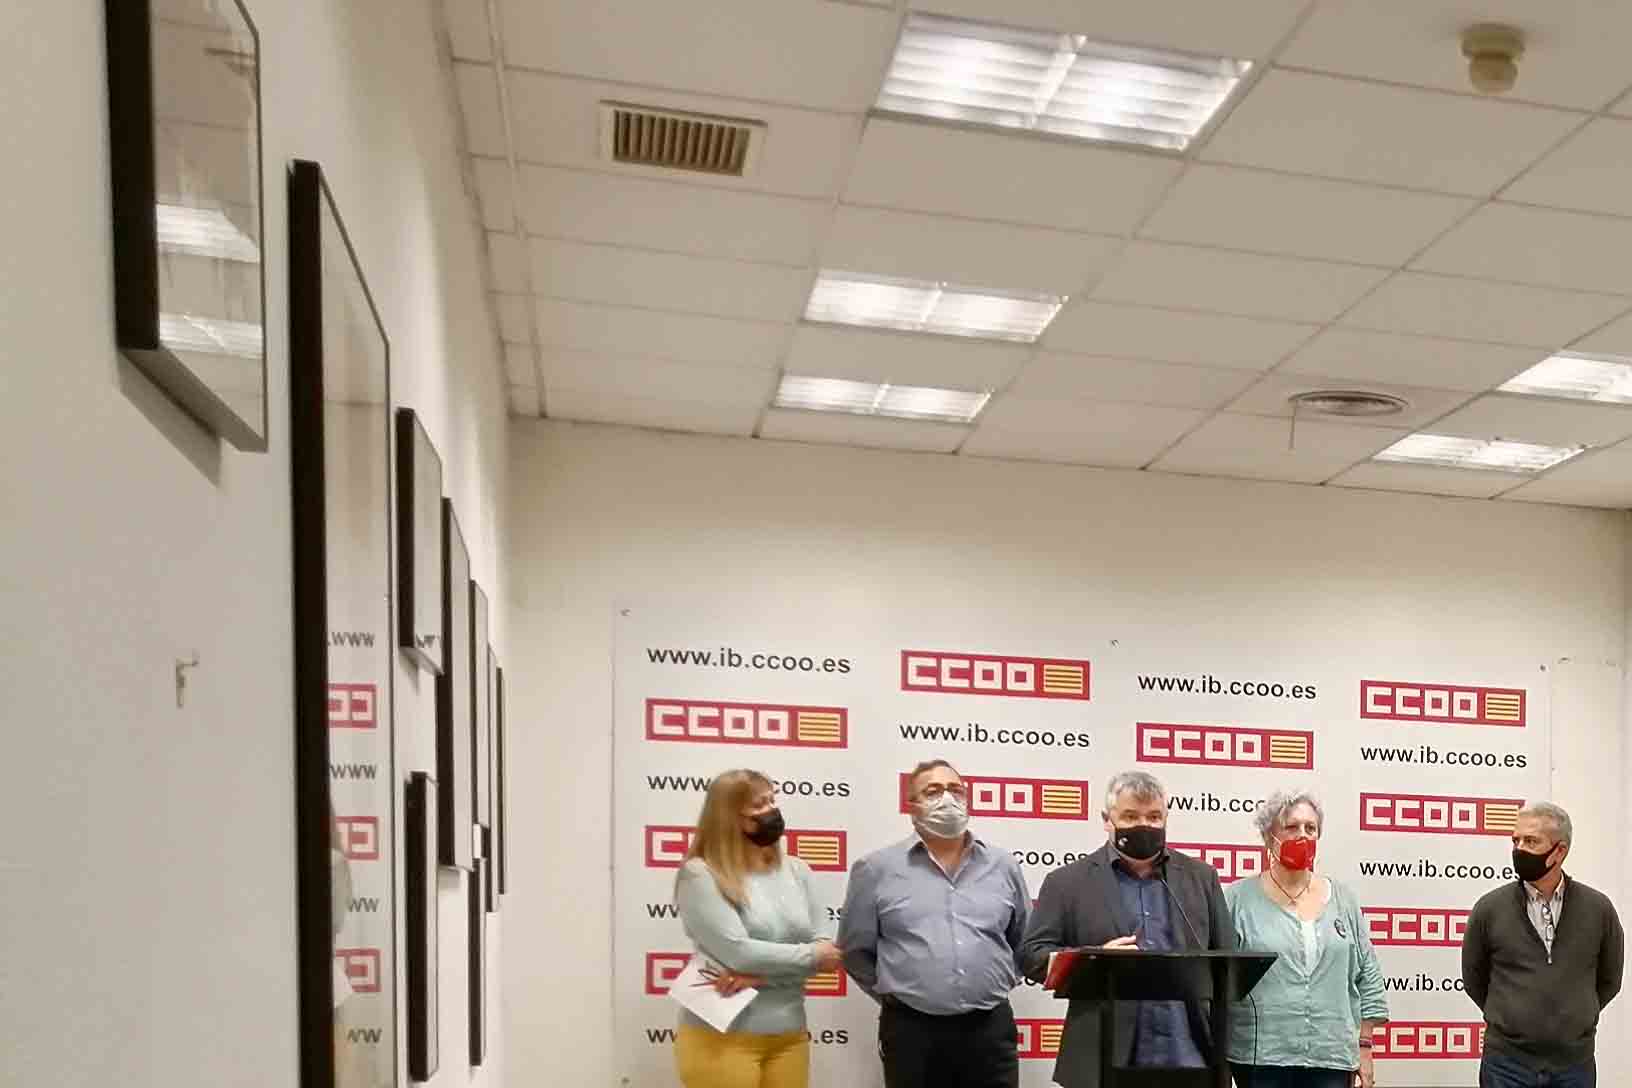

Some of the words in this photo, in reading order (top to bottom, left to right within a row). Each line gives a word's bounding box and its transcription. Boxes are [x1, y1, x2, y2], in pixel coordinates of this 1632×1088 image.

[647, 648, 851, 673] www.ib.ccoo.es
[908, 656, 1035, 691] CCOO
[1138, 675, 1317, 699] www.ib.ccoo.es
[1366, 687, 1478, 719] CCOO
[653, 705, 789, 740] CCOO
[899, 724, 1090, 748] www.ib.ccoo.es
[1143, 728, 1262, 761] CCOO
[1360, 746, 1528, 768] www.ib.ccoo.es
[1366, 798, 1477, 829] CCOO
